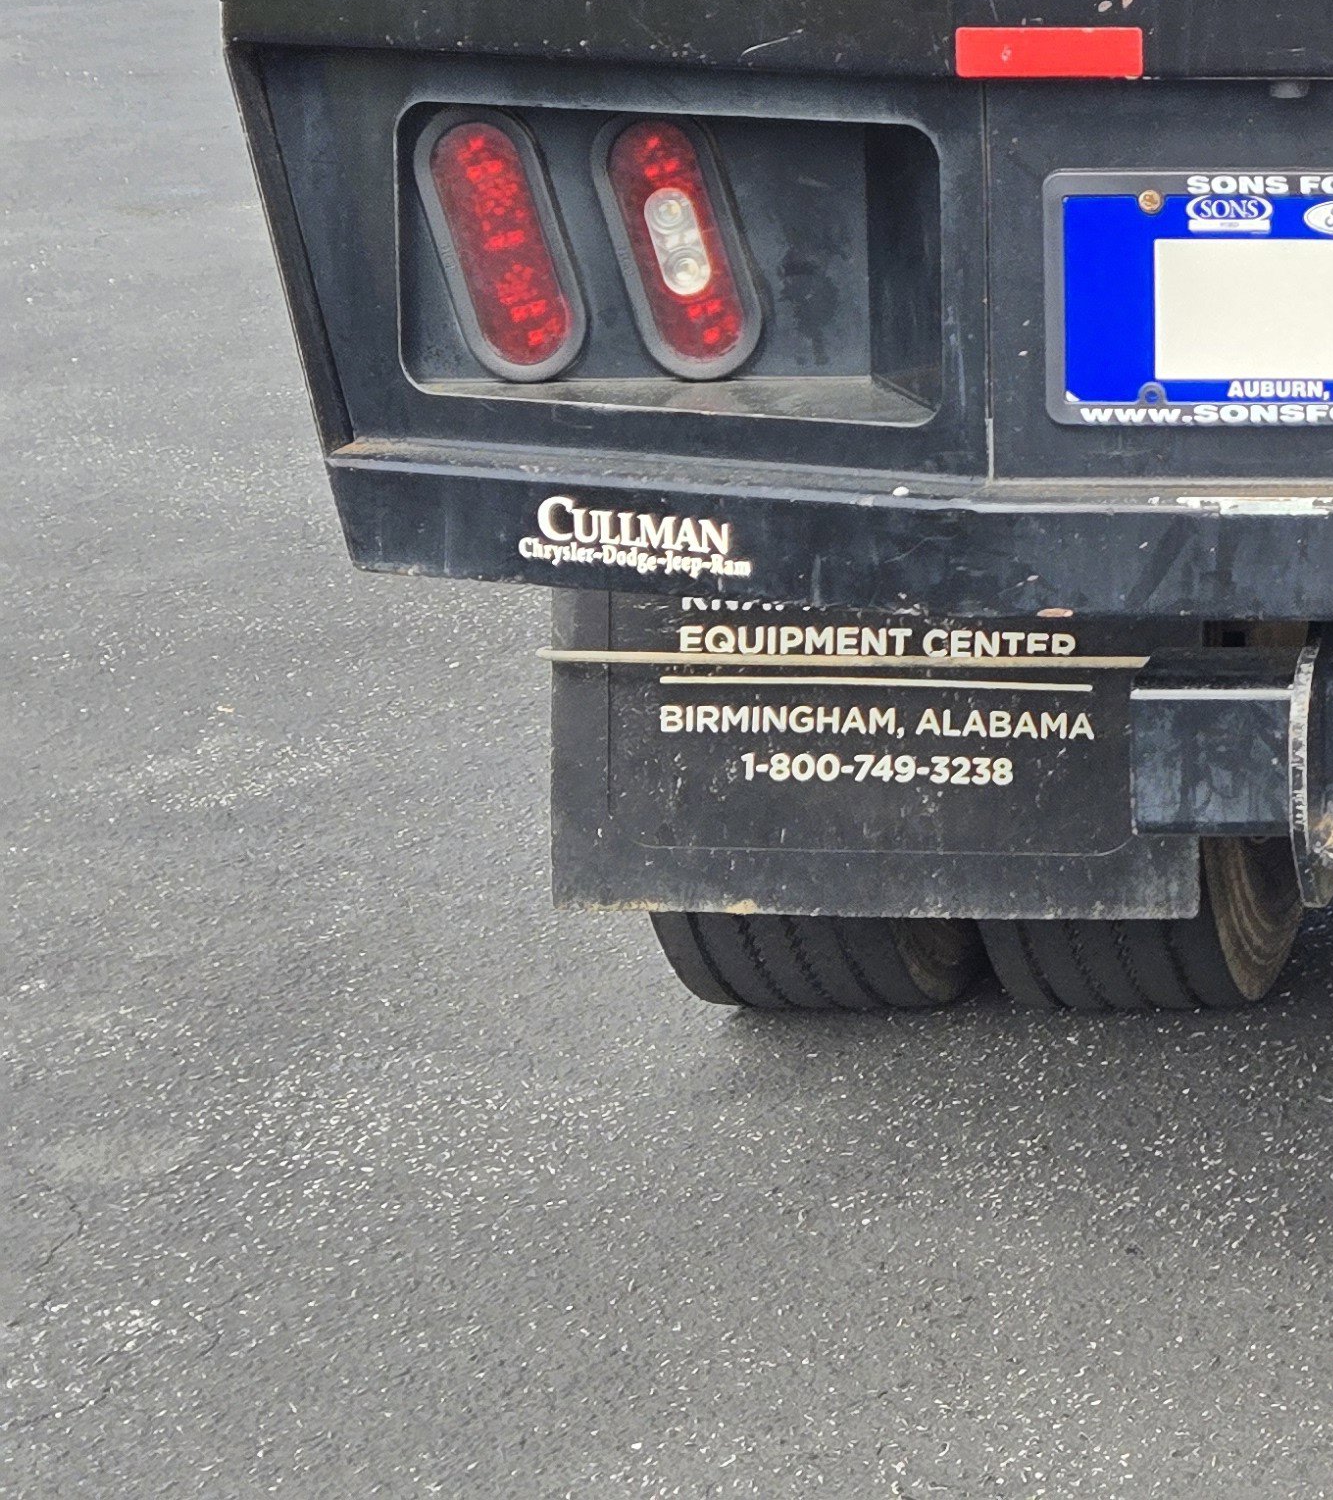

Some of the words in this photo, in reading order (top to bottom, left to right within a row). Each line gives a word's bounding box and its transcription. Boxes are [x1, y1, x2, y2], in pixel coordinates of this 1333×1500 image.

[1186, 175, 1290, 195] SONS
[1199, 199, 1260, 219] SONS
[1226, 380, 1330, 400] AUBURN,
[537, 495, 731, 555] CULLMAN
[677, 625, 913, 657] EQUIPMENT
[921, 629, 1077, 658] CENTER
[659, 704, 905, 739] BIRMINGHAM,
[914, 708, 1096, 741] ALABAMA
[740, 752, 1014, 786] 1-800-749-3238
